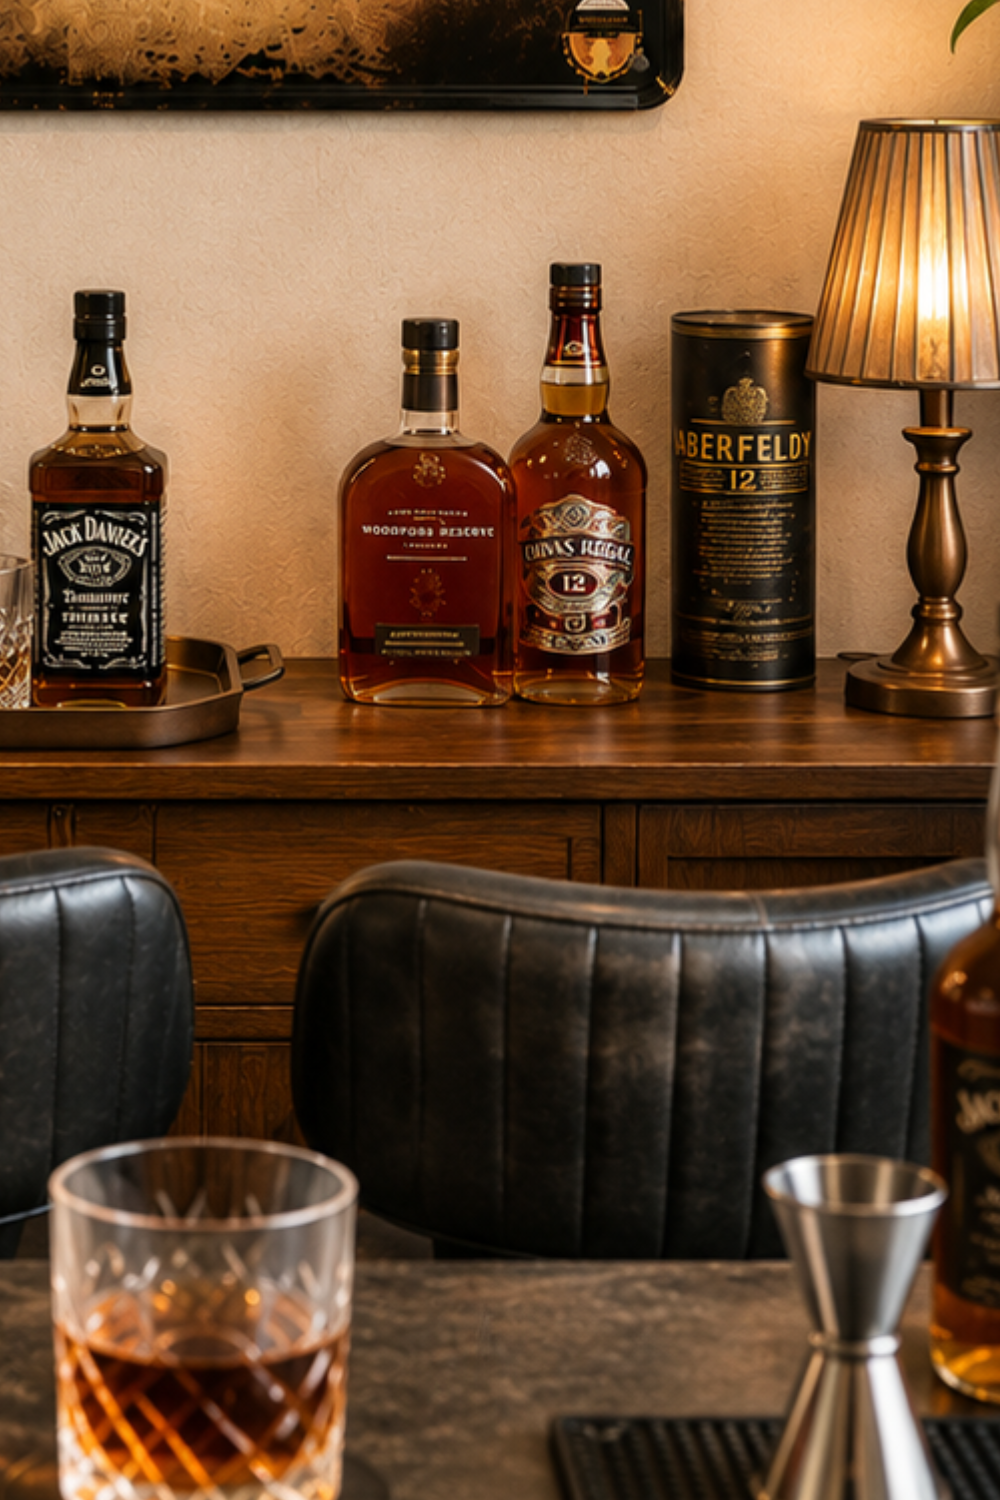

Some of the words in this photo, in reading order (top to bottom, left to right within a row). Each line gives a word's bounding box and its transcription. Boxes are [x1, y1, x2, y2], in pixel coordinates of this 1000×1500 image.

[674, 429, 812, 461] ABERFELDY
[731, 469, 756, 490] 12
[562, 574, 586, 592] 12
